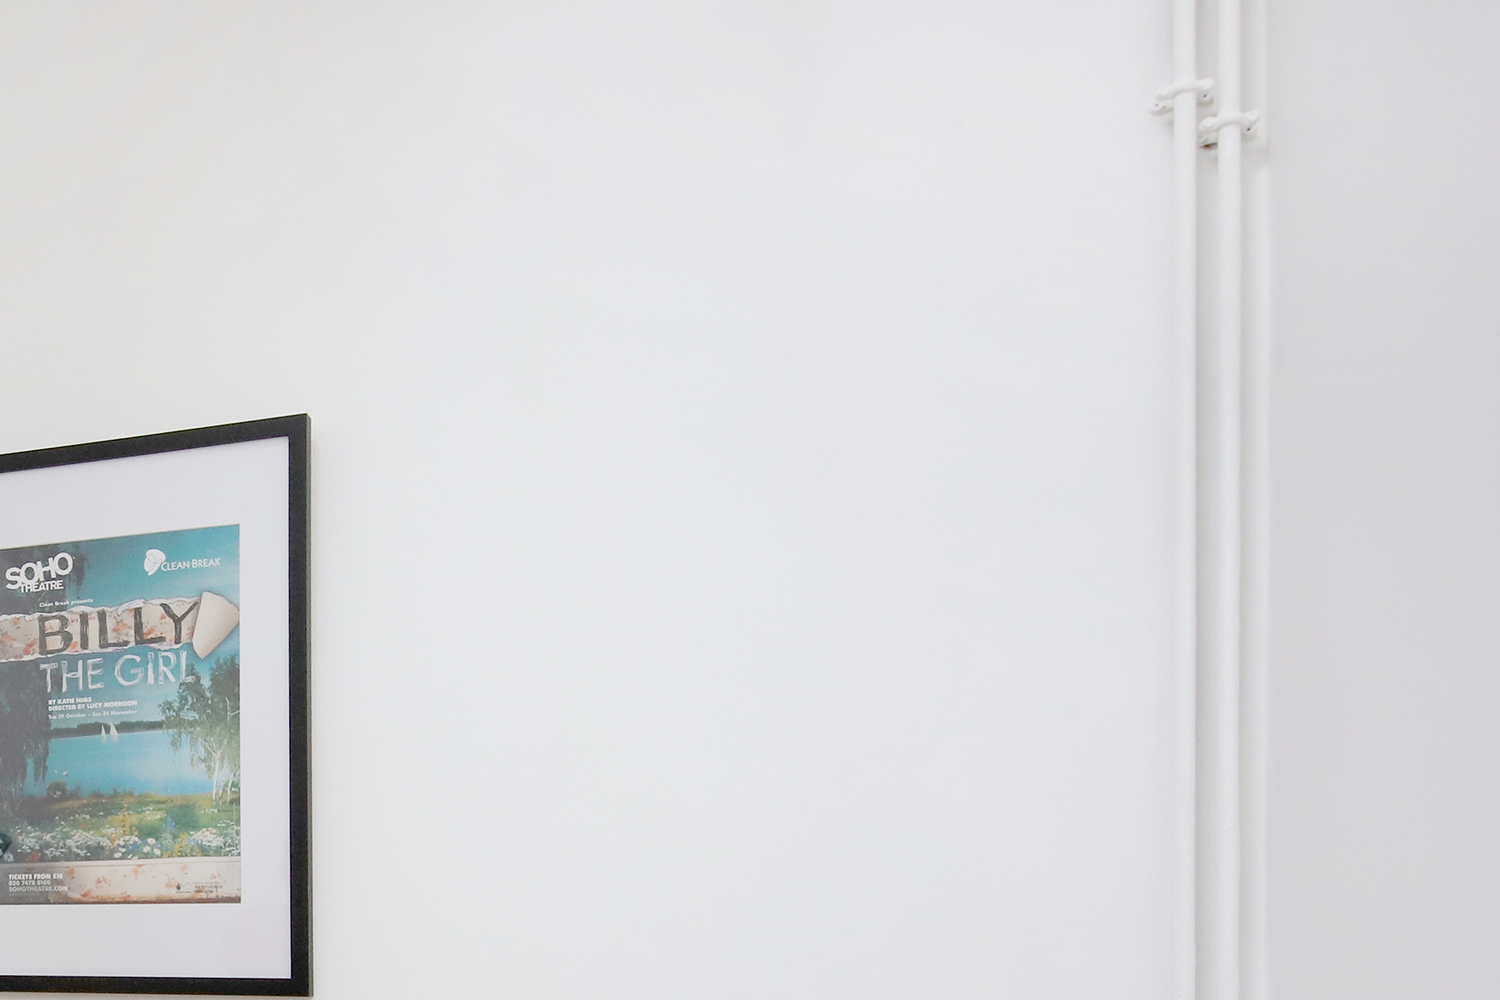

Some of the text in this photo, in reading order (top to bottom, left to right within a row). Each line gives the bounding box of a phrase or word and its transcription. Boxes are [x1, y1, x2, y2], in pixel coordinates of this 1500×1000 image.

[5, 552, 73, 590] SOHO
[160, 557, 221, 572] CLEAN BREAK
[20, 580, 64, 593] THEATRE
[37, 600, 199, 655] BILLY
[39, 650, 196, 693] THE GIRL
[48, 704, 77, 712] DIRECTED
[103, 700, 138, 708] MORRISON
